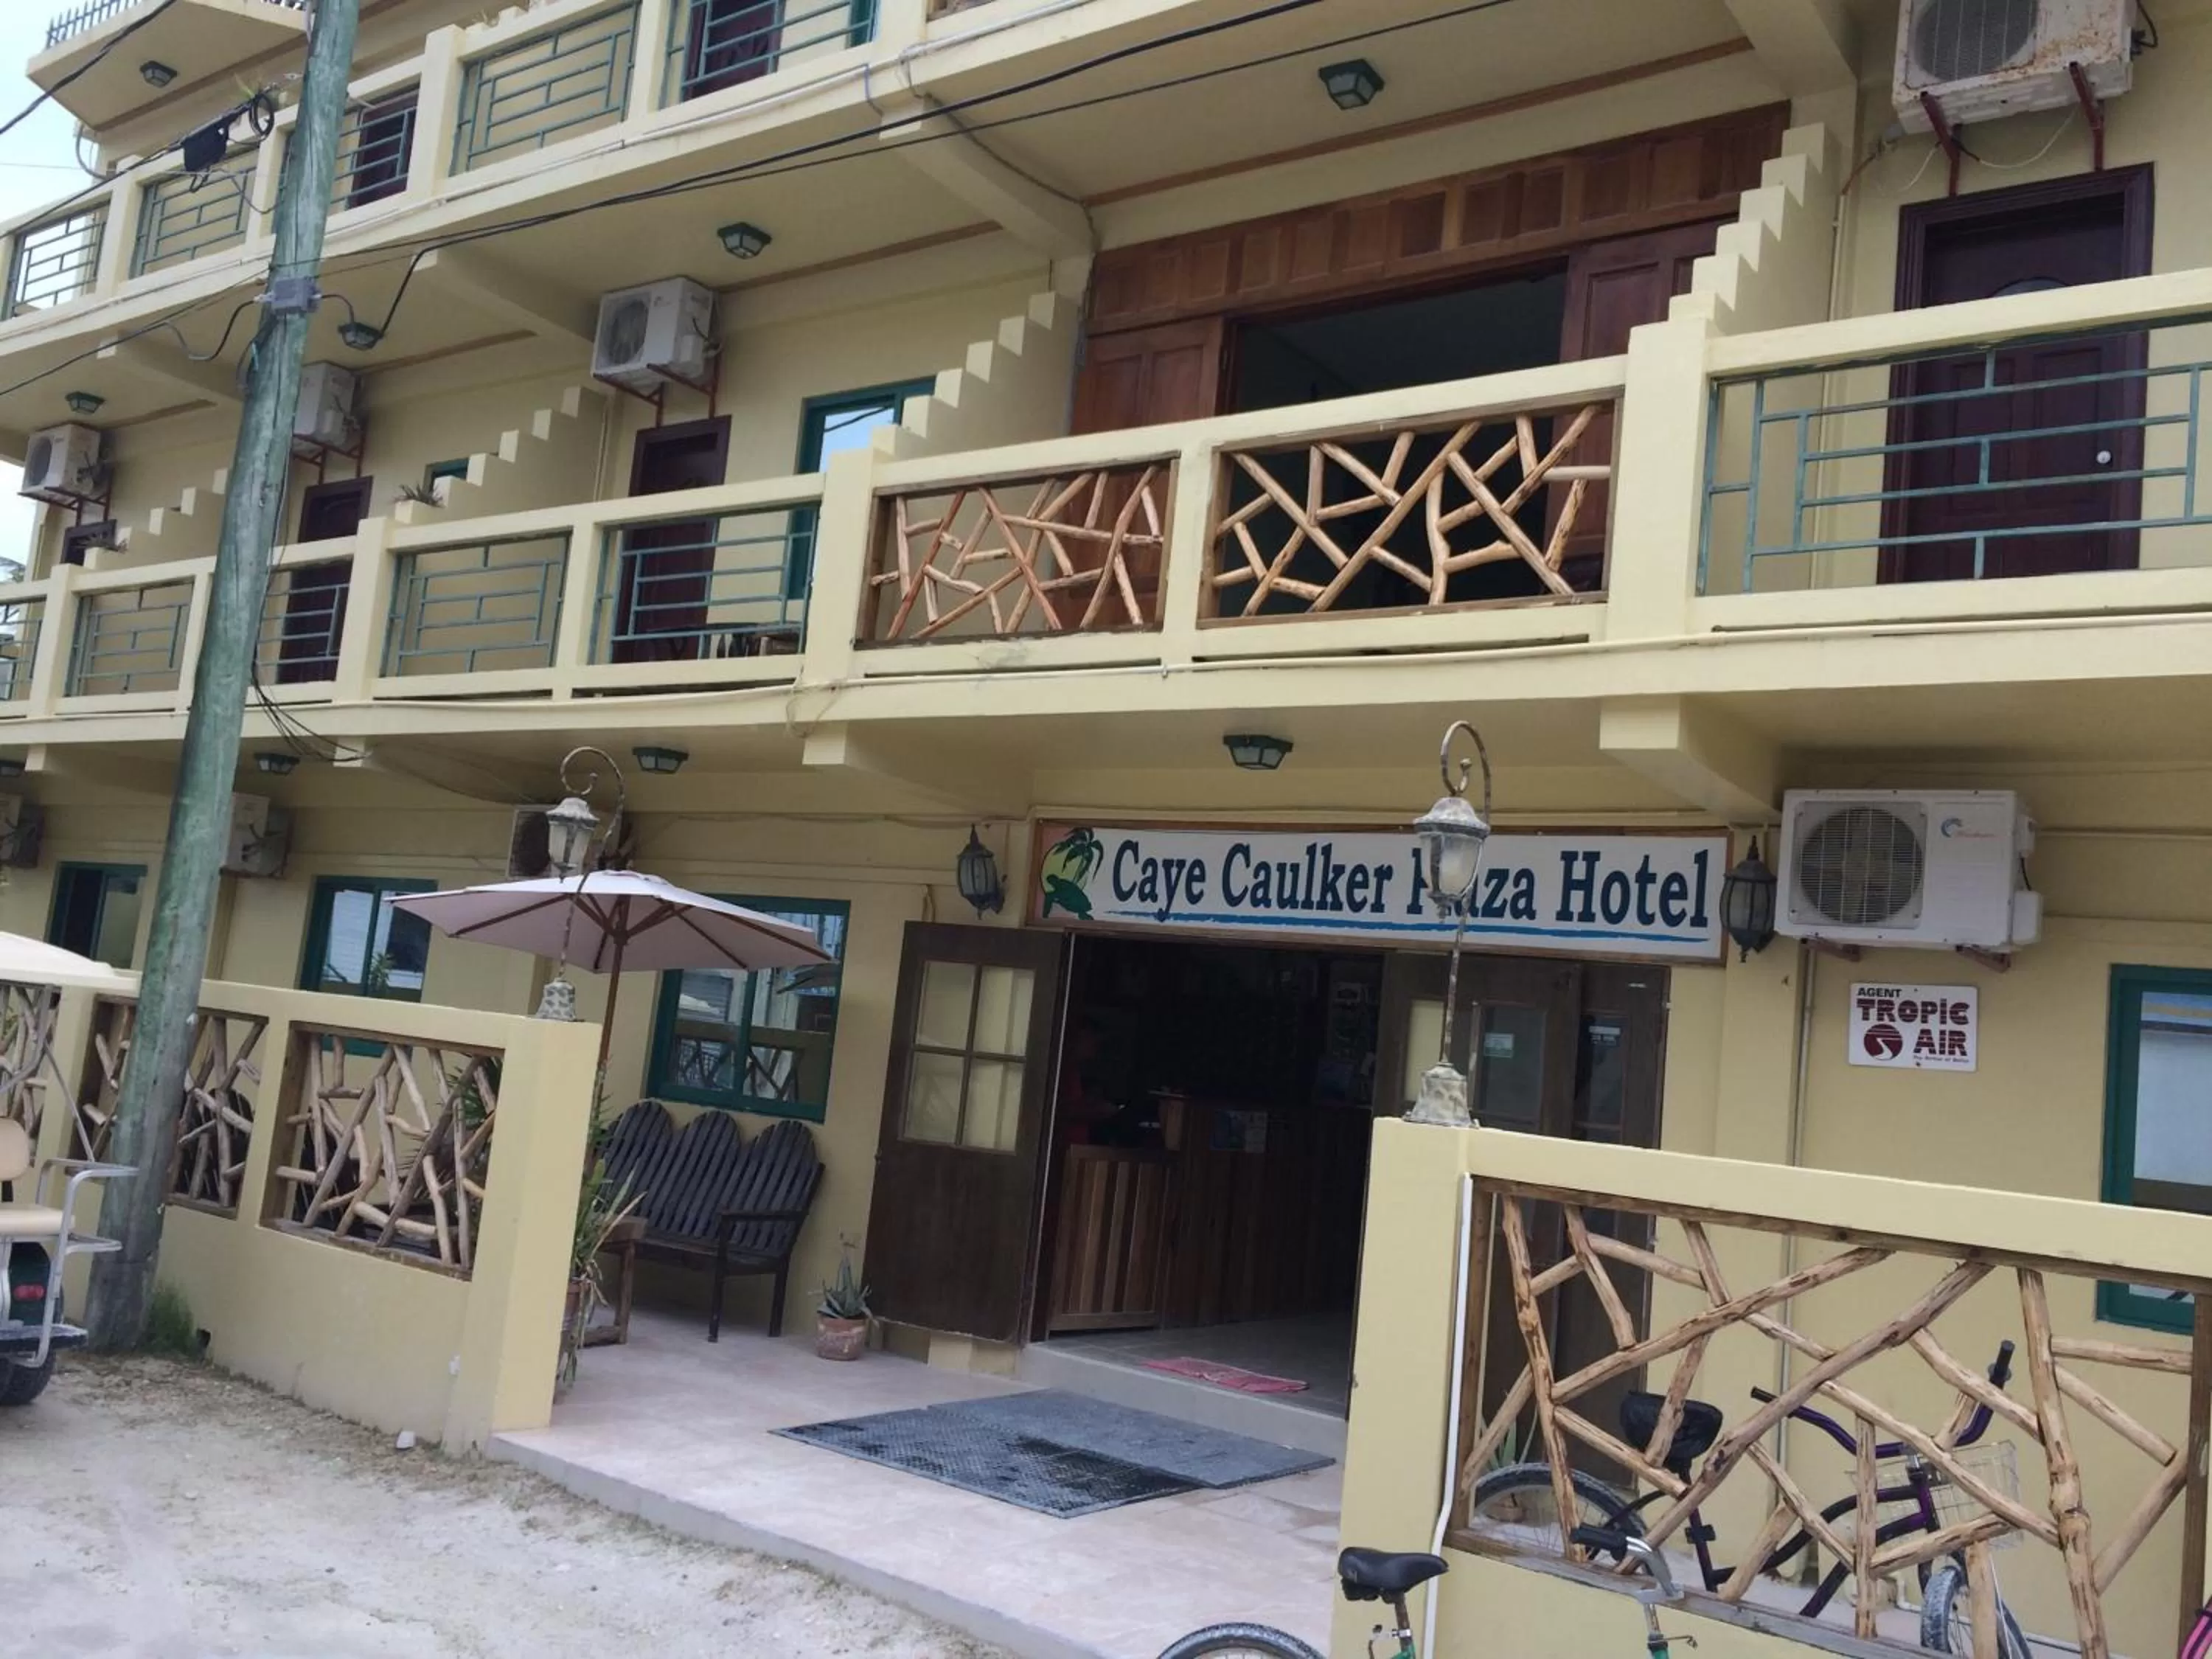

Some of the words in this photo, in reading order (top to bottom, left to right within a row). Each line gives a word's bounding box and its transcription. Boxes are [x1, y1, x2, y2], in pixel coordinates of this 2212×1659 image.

[1112, 839, 1206, 922] Caye
[1222, 841, 1394, 914] Caulker
[1406, 847, 1537, 920] Pza
[1555, 848, 1709, 928] Hotel
[1857, 987, 1902, 998] AGENT
[1913, 1029, 1968, 1056] AIR
